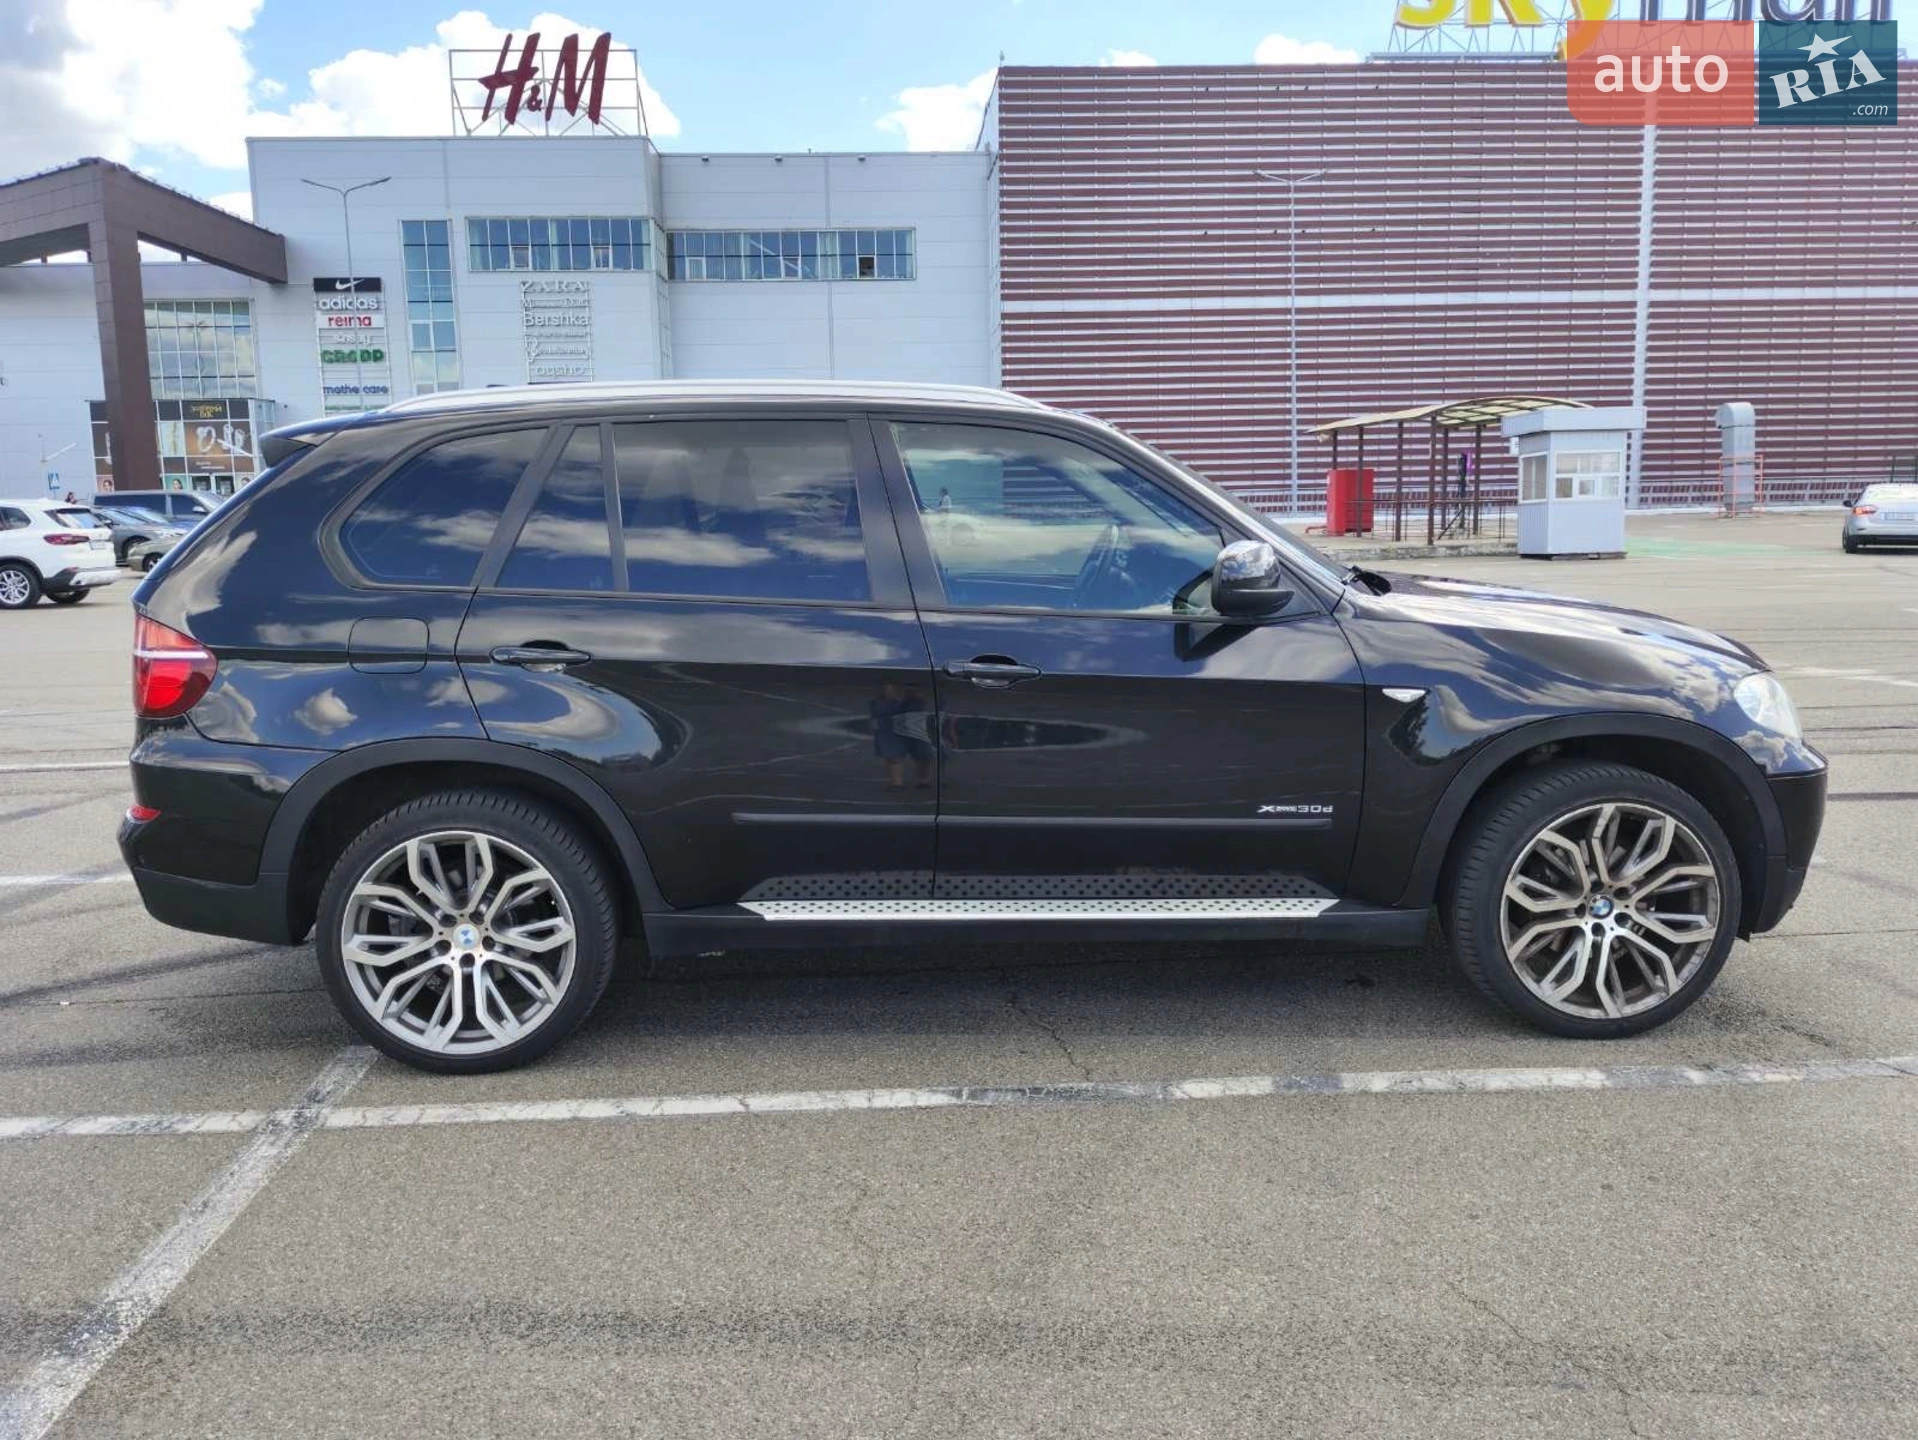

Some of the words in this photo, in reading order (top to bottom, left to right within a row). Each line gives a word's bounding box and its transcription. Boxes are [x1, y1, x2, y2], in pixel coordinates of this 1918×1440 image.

[478, 32, 611, 125] H&M
[319, 295, 379, 311] adidas
[524, 310, 589, 327] Bershka
[323, 383, 388, 395] mothecare
